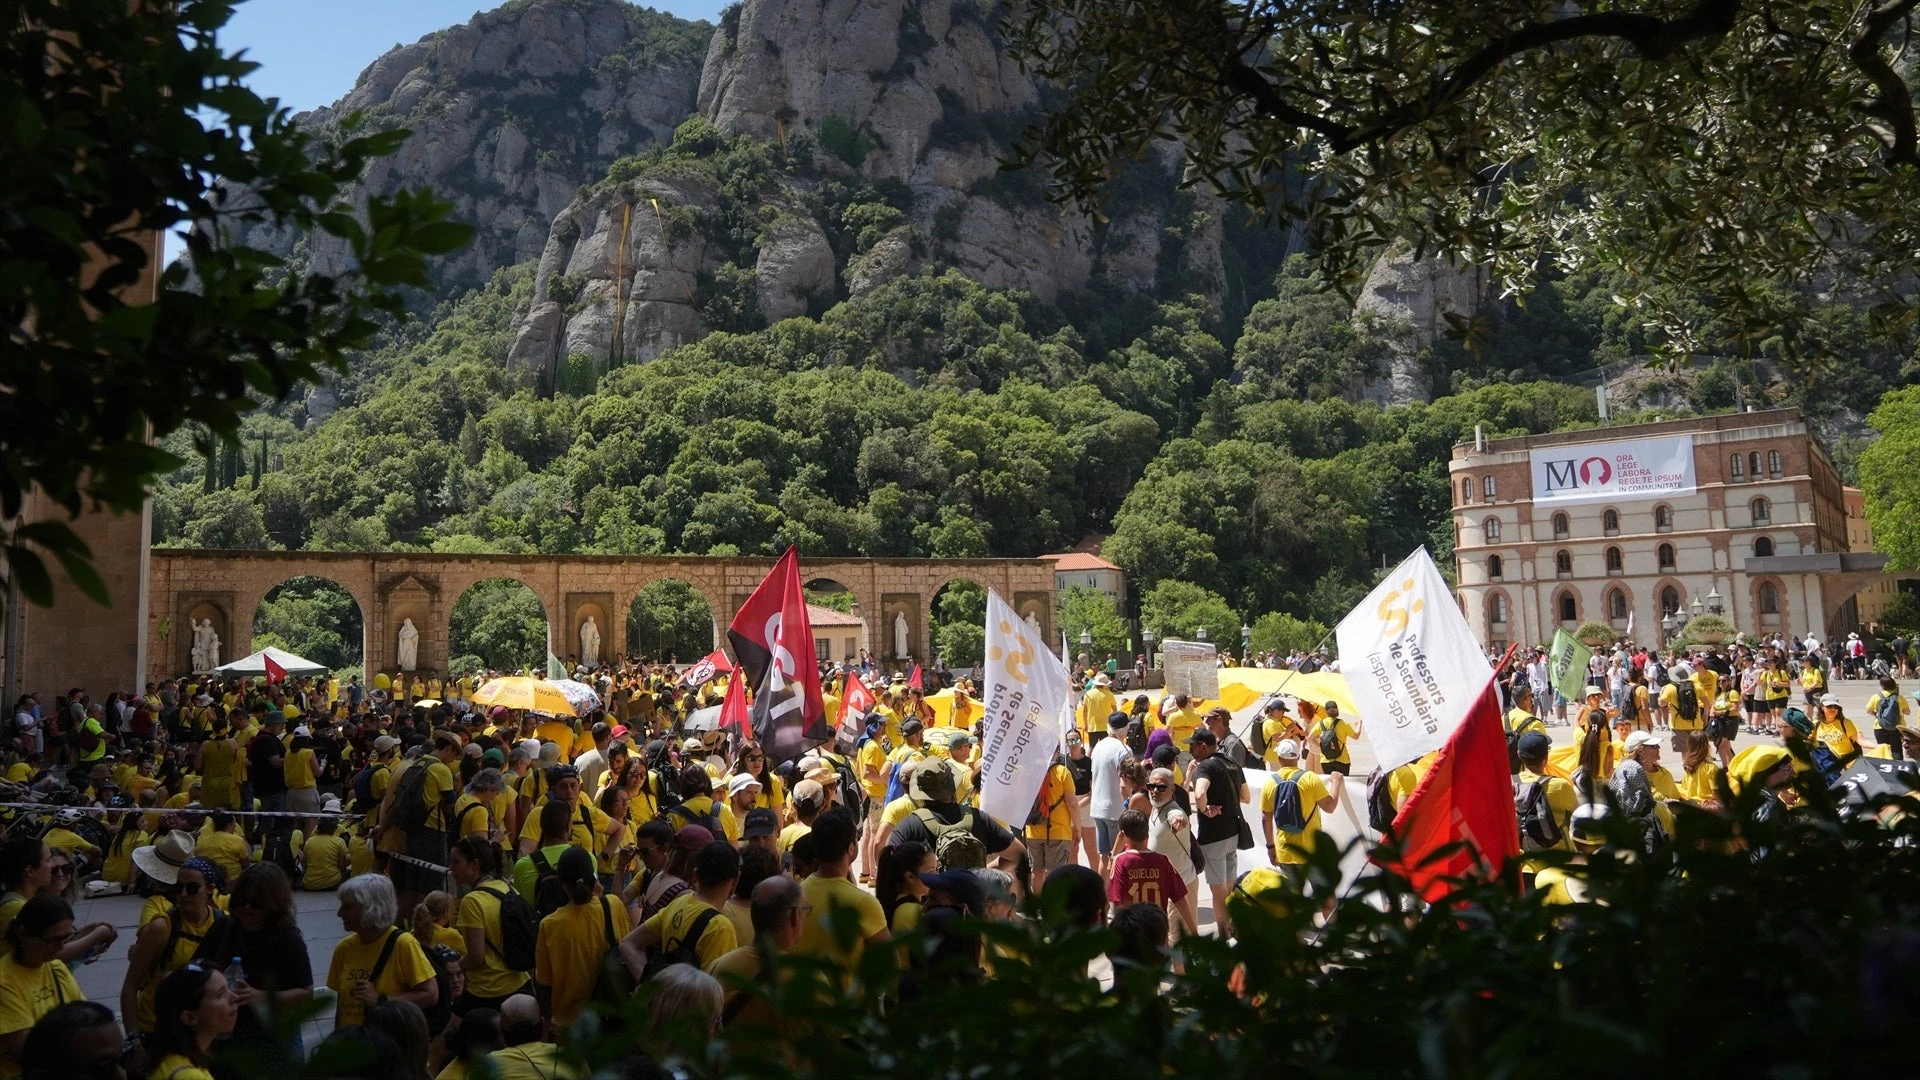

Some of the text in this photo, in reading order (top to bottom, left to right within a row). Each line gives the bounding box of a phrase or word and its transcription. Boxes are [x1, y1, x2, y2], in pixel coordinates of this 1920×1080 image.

[1616, 454, 1634, 462] ORA
[1617, 461, 1638, 470] LEGE
[1618, 468, 1651, 478] LABORA
[1618, 473, 1683, 486] REGE TE IPSUM
[1628, 481, 1683, 492] COMMUNITATE
[1388, 642, 1403, 660] de
[1405, 633, 1445, 706] Professors
[346, 968, 371, 981] SOS
